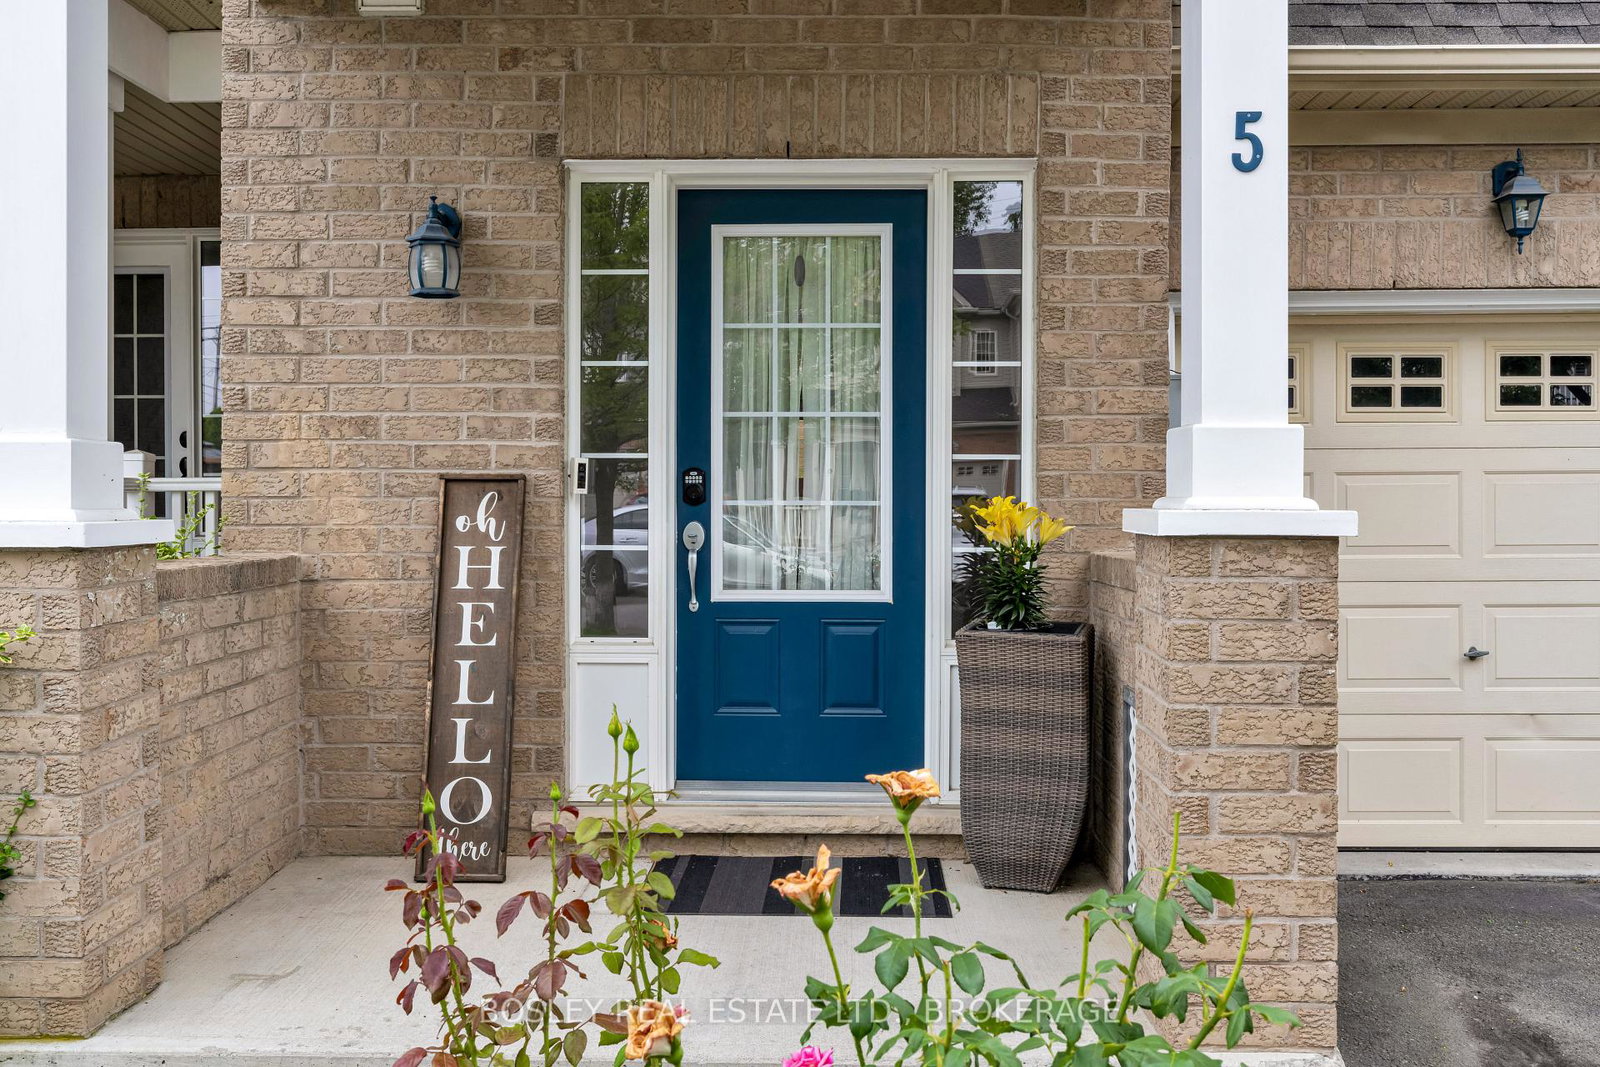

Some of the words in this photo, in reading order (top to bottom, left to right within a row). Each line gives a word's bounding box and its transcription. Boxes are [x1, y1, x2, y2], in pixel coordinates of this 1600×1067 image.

[1231, 111, 1264, 173] 5
[455, 491, 506, 542] oh
[439, 545, 507, 825] HELLO
